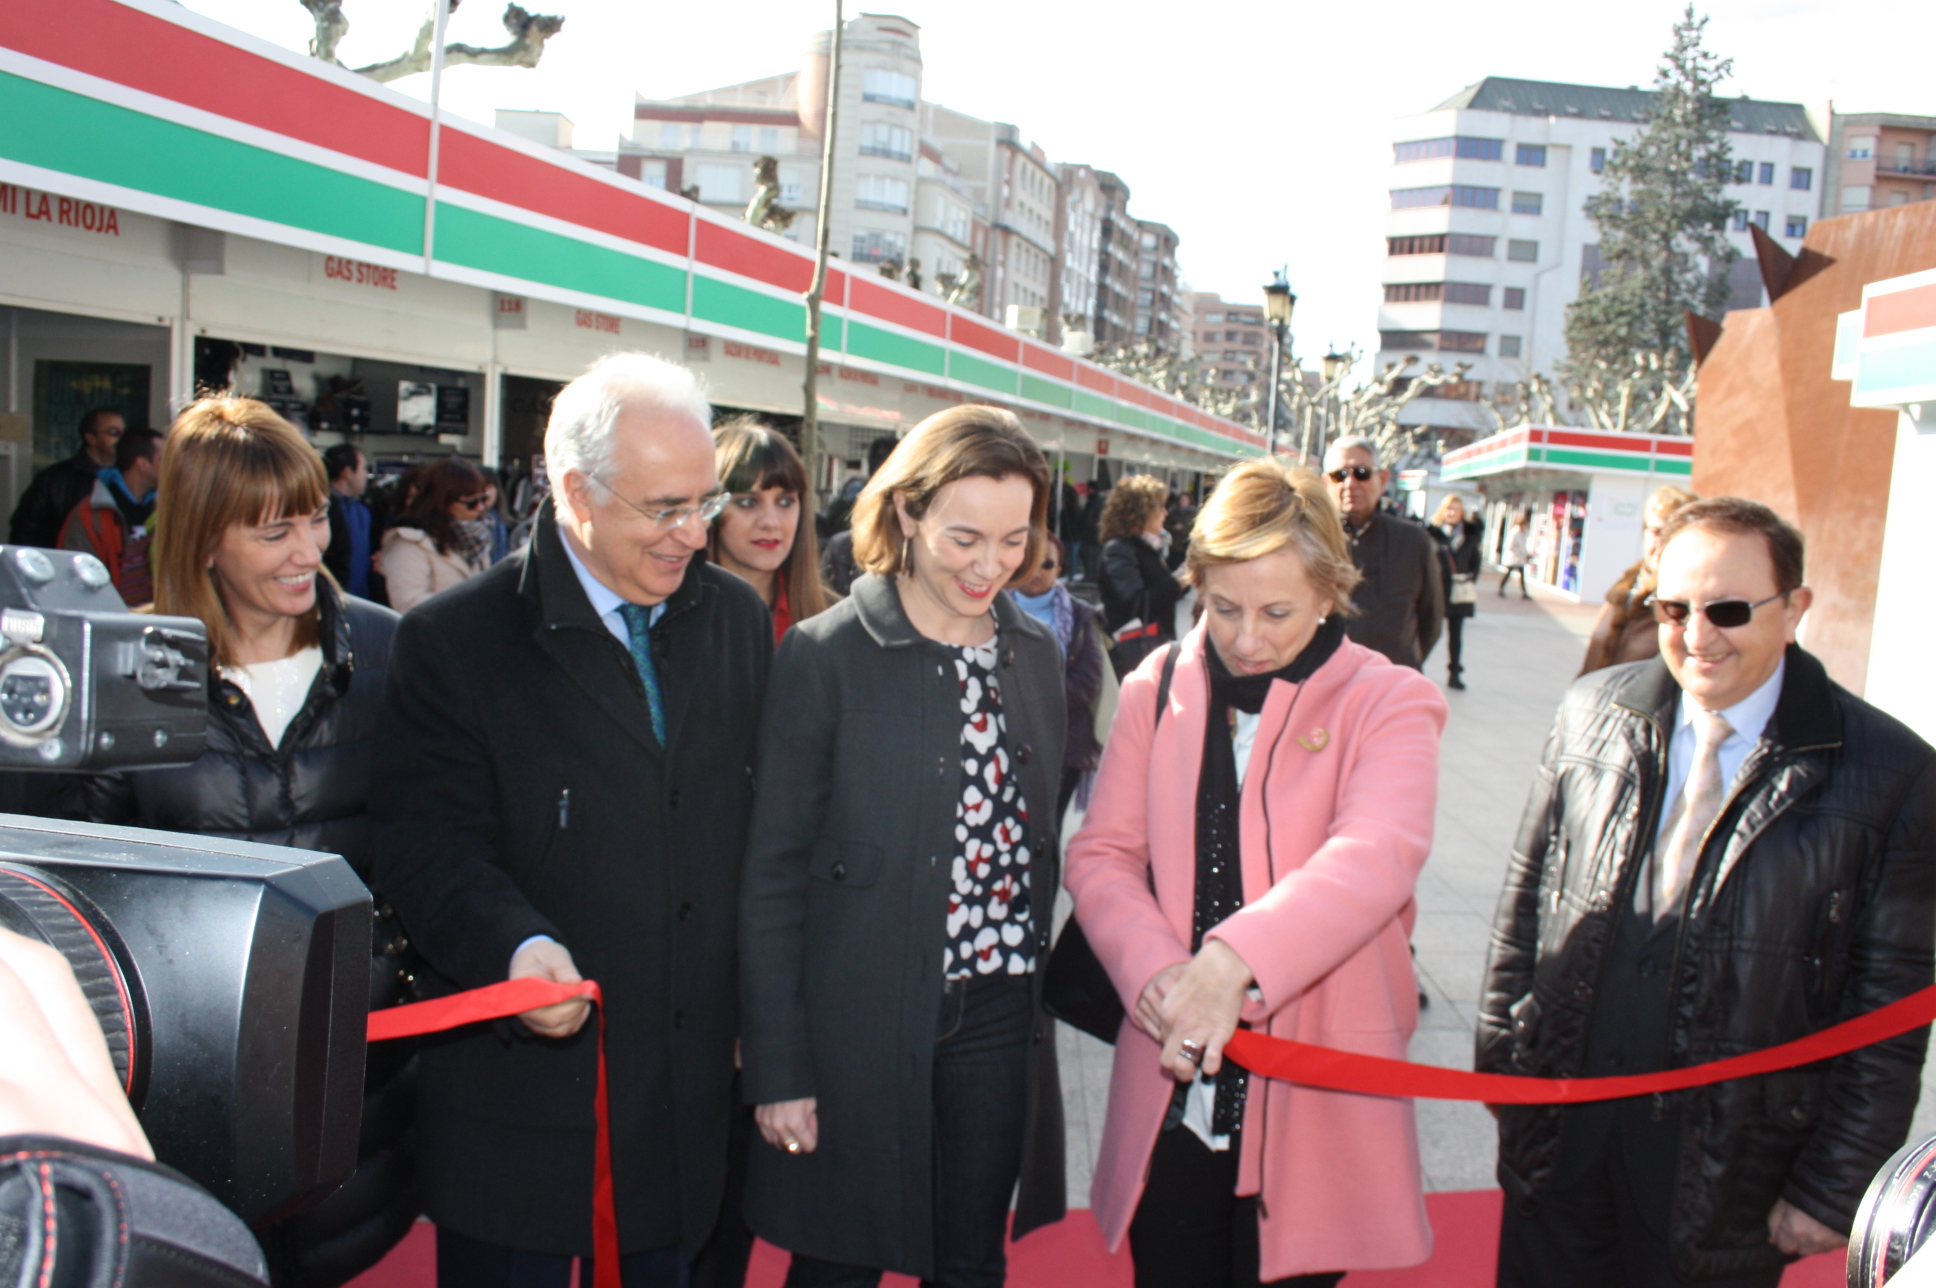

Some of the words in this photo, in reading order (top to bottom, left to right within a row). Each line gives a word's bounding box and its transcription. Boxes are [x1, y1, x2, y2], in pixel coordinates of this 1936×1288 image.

[25, 189, 52, 223] LA
[58, 196, 120, 236] RIOJA
[324, 254, 353, 283] GAS
[356, 261, 398, 290] STORE
[575, 309, 593, 328] GAS
[594, 313, 621, 335] STORE
